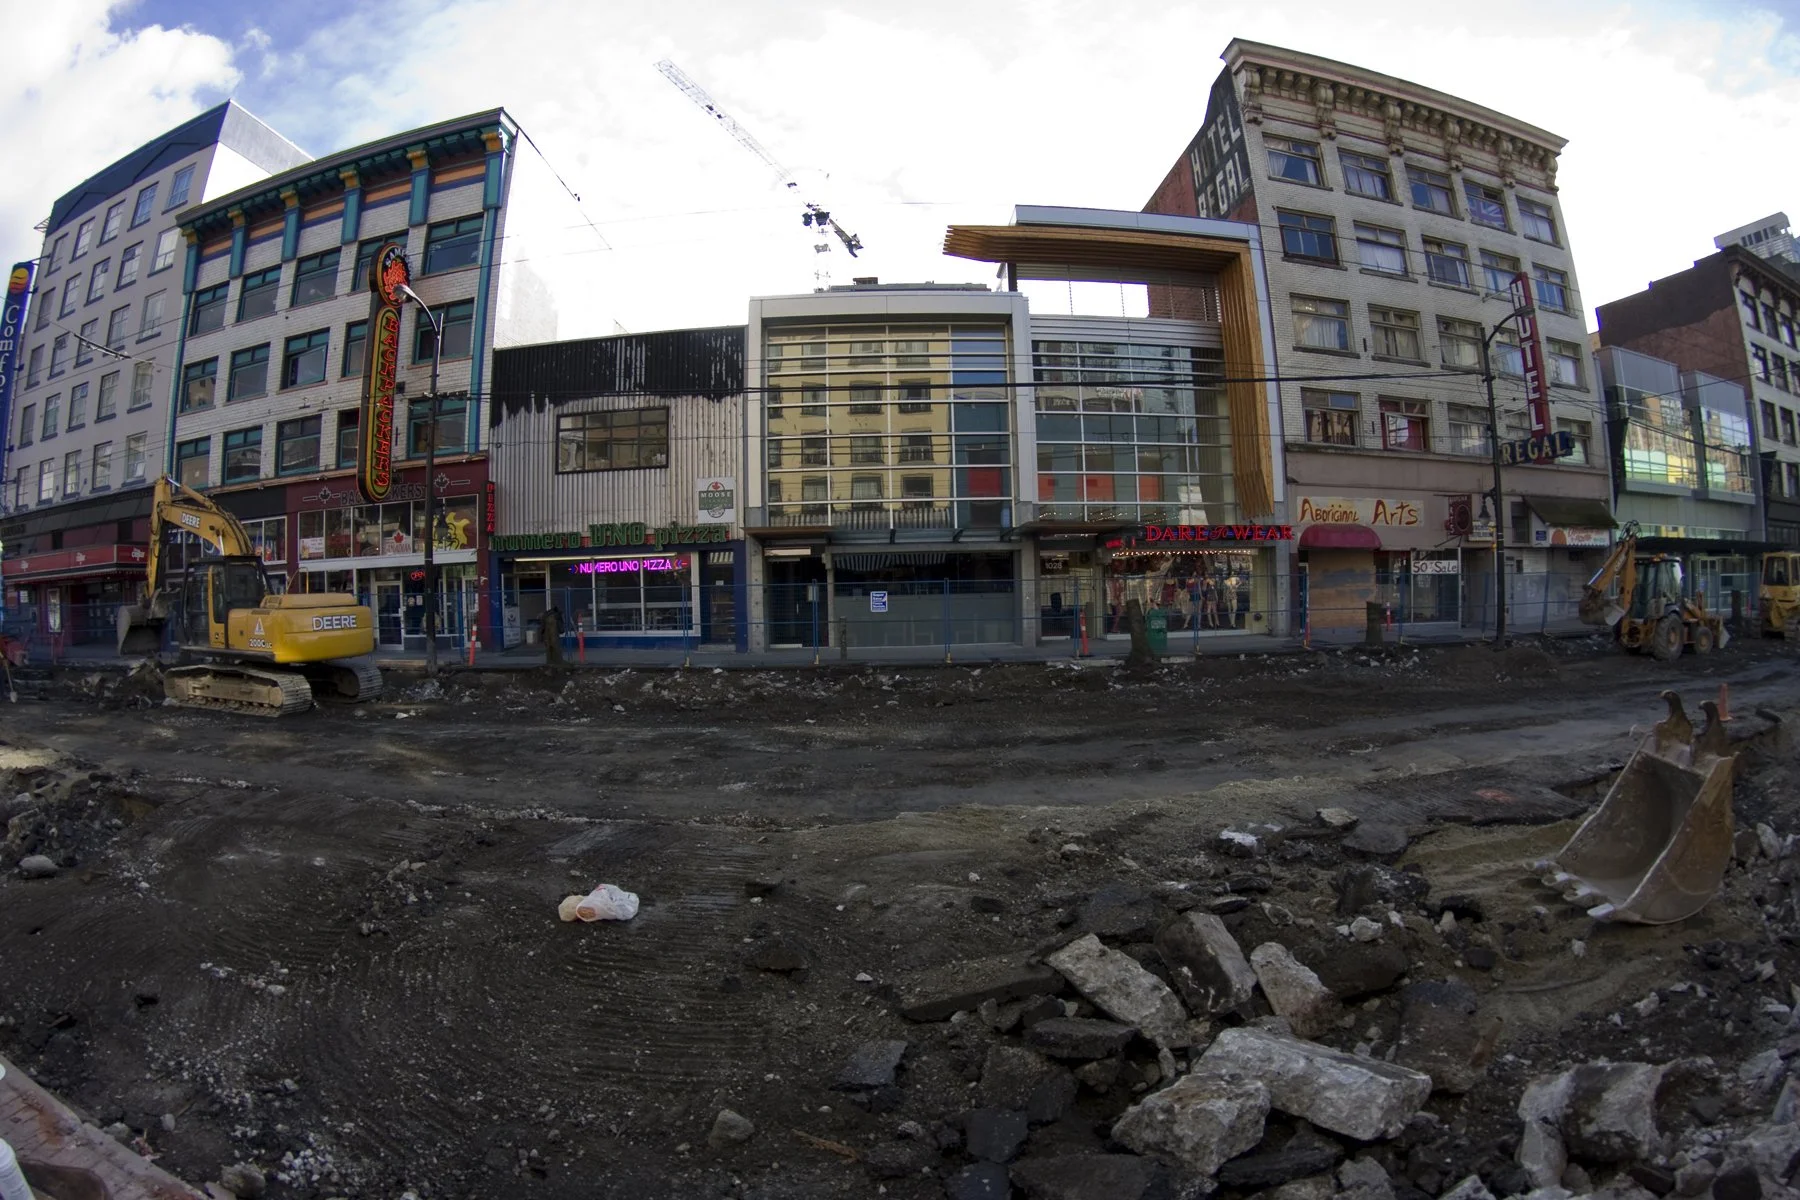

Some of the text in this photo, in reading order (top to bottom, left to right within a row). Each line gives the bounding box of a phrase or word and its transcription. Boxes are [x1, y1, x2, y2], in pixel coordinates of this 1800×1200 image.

[1191, 105, 1241, 189] HOTEL
[1511, 280, 1544, 432] HOTEL
[374, 316, 399, 488] BACKPACKERS
[1502, 432, 1566, 465] REGAL
[181, 512, 200, 528] DEERE
[486, 484, 495, 533] PIZZA
[1371, 499, 1419, 525] Arts
[488, 521, 729, 551] numero UNO pizza
[1145, 525, 1206, 542] DARE
[1231, 525, 1294, 542] WEAR
[579, 559, 672, 574] NUMERO UNO PIZZA
[1045, 561, 1063, 569] 1028
[1434, 561, 1457, 574] Sale
[312, 615, 357, 630] DEERE
